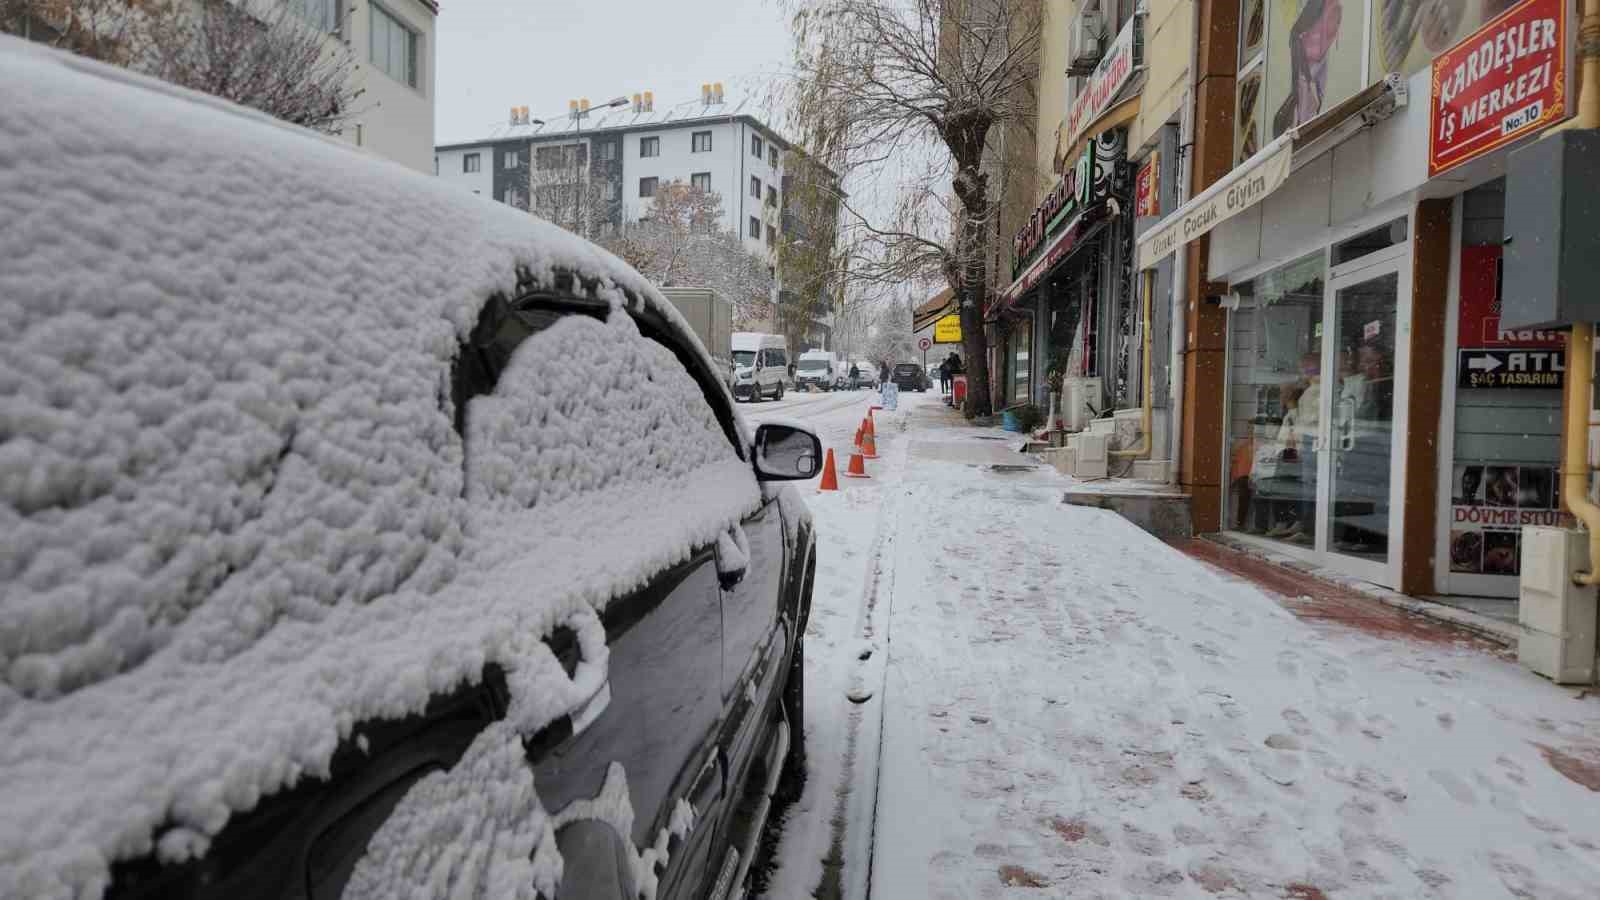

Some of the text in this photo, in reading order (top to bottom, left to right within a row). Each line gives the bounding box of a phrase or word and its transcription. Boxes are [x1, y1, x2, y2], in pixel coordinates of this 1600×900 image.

[1440, 18, 1556, 110] KARDEŞLER
[1439, 53, 1553, 143] İŞ MERKEZİ
[1226, 175, 1266, 210] Giyim
[1500, 373, 1558, 384] TASARIM
[1455, 506, 1518, 524] DÖVME
